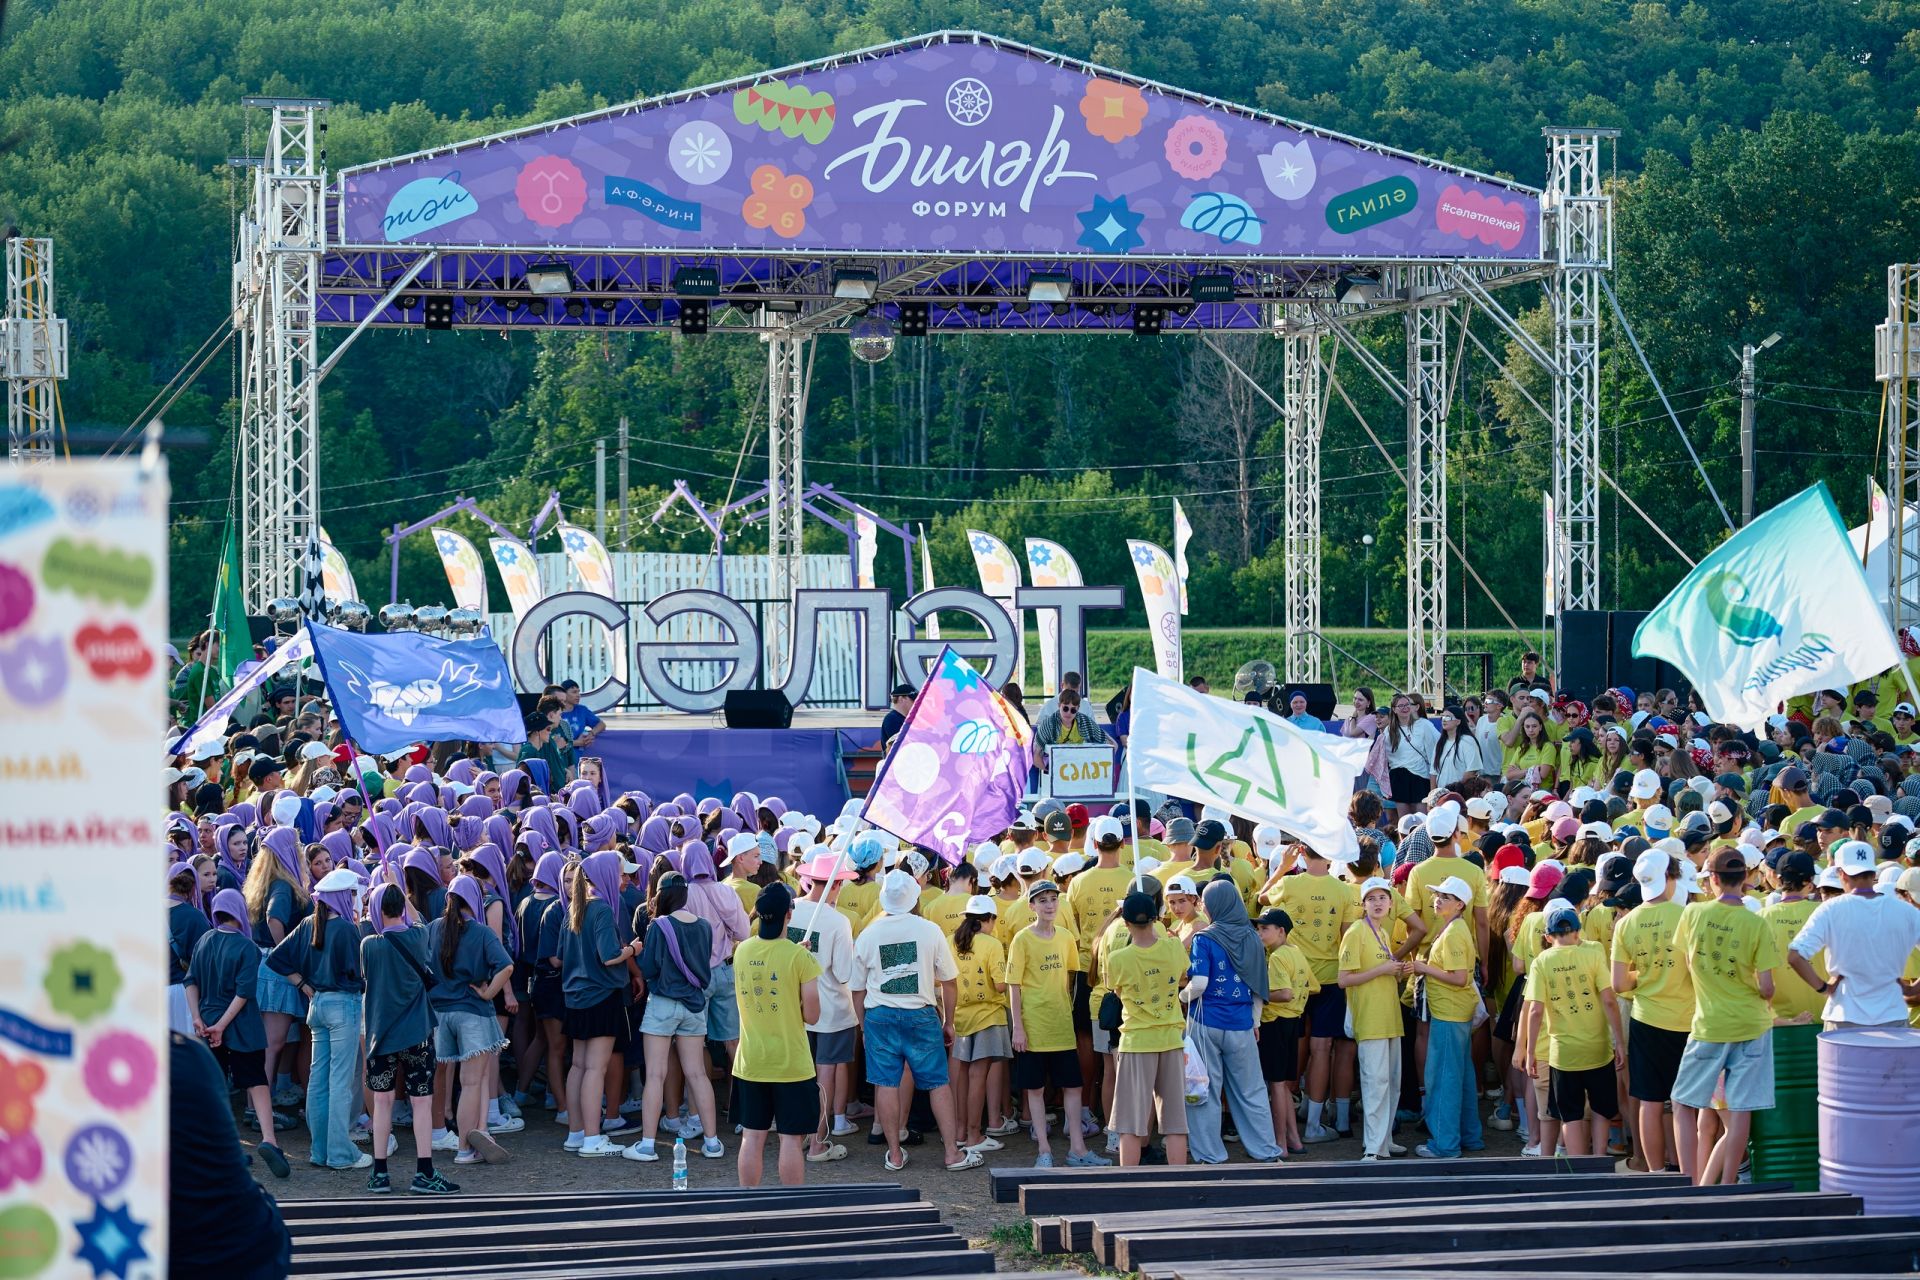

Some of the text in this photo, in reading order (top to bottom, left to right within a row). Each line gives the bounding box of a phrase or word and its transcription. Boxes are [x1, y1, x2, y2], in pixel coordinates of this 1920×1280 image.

[824, 99, 1098, 213] Биләр
[911, 200, 1006, 217] ФОРУМ
[1337, 188, 1408, 223] ГАИЛӘ
